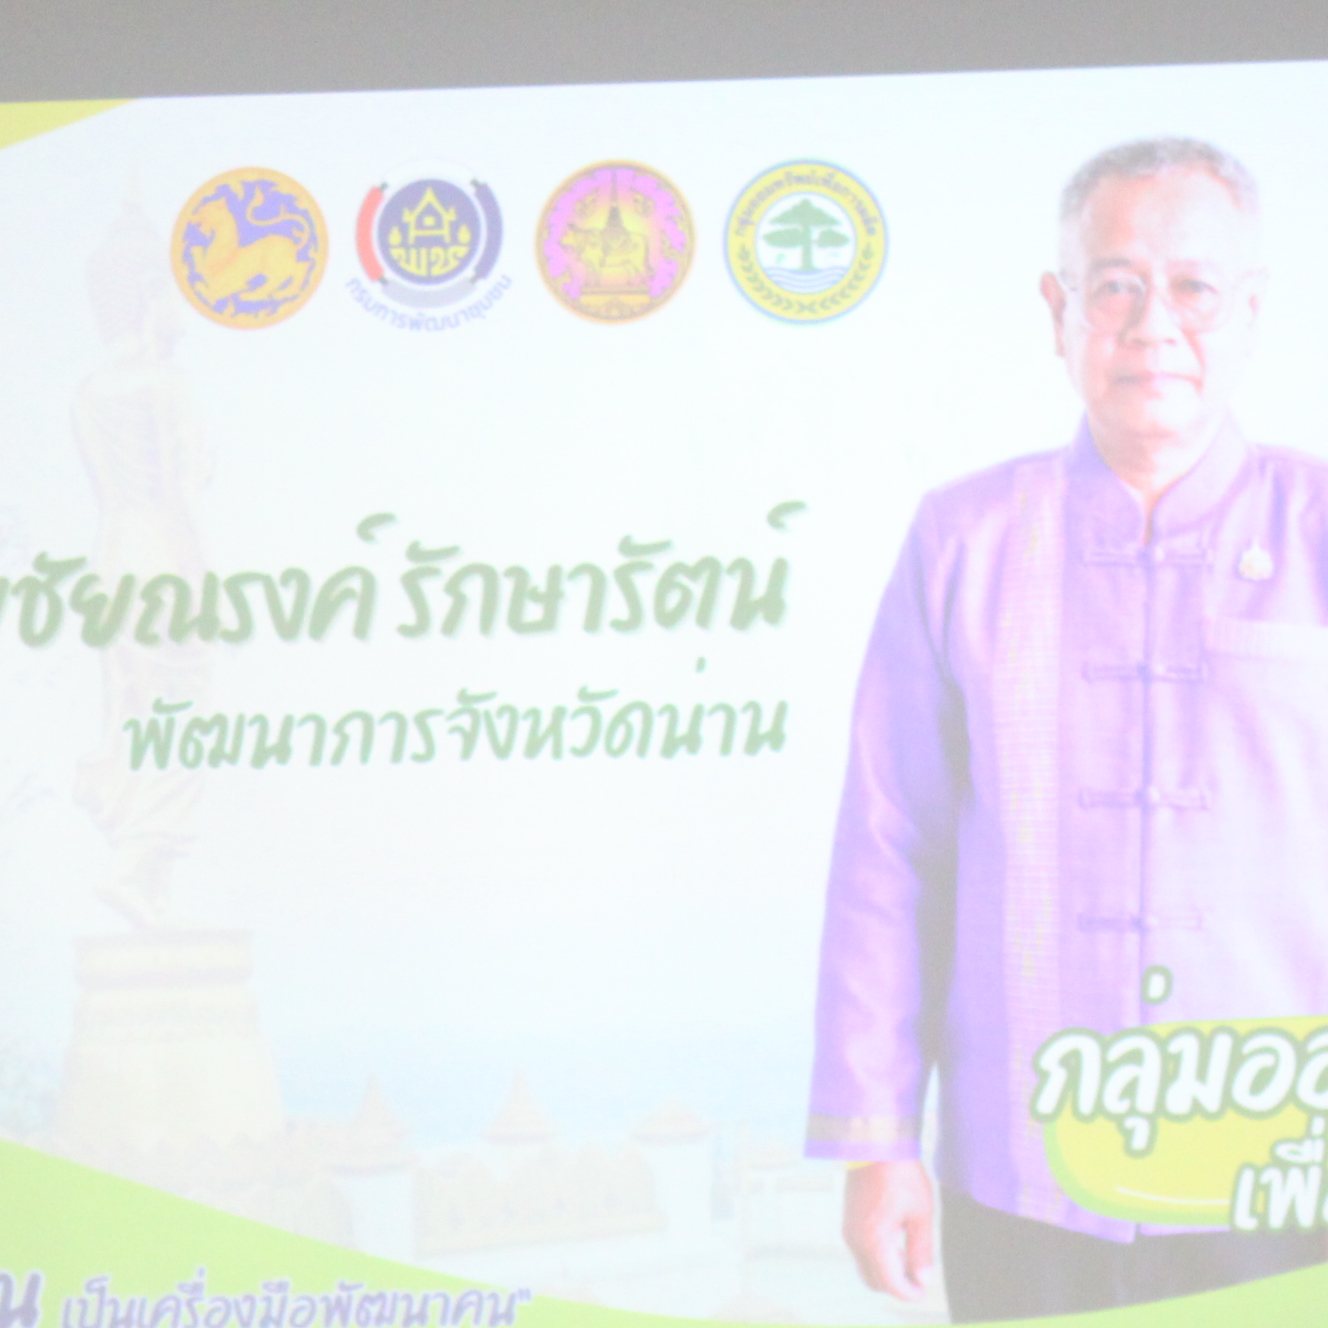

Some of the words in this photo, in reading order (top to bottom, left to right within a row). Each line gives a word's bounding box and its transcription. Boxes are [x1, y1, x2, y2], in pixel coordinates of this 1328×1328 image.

[344, 273, 514, 332] กรมการพัฒนาชุมชน
[396, 499, 809, 640] รักษารัตน์
[121, 655, 790, 771] พัฒนาการจังหวัดน่าน
